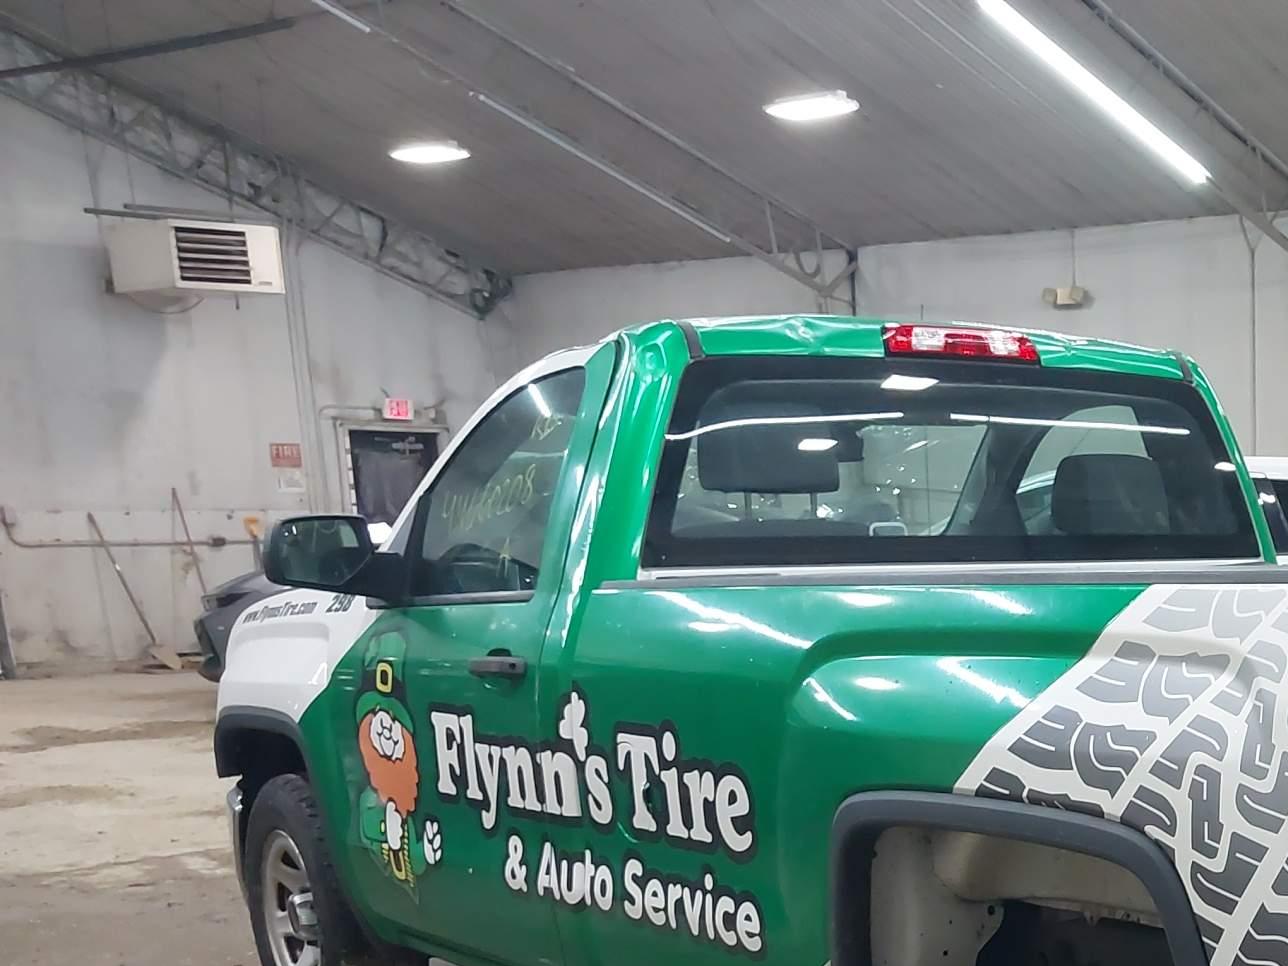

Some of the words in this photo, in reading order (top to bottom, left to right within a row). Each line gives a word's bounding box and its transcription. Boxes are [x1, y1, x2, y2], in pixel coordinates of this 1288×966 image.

[325, 594, 356, 613] 298
[431, 692, 613, 830] Flynn's
[616, 731, 753, 852] Tire
[504, 835, 527, 893] &
[537, 841, 614, 911] Auto
[623, 858, 763, 952] Service
